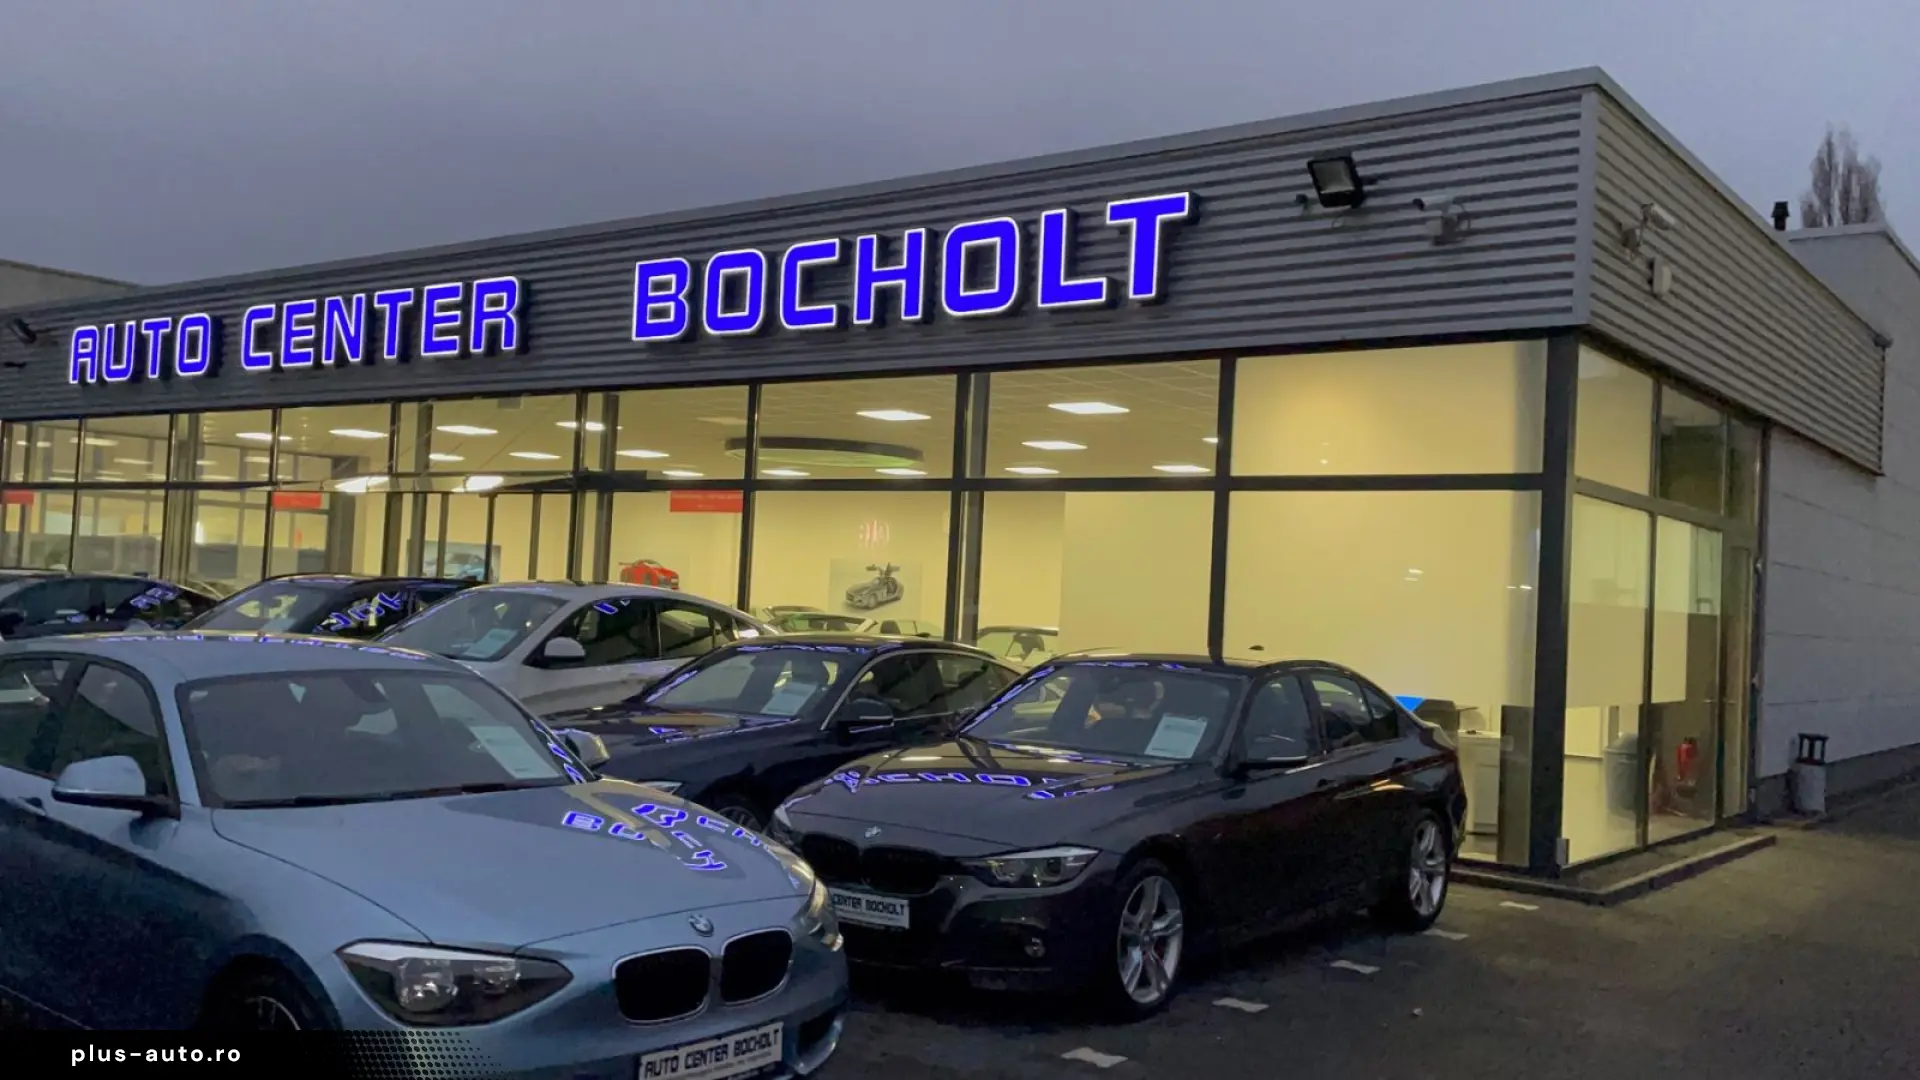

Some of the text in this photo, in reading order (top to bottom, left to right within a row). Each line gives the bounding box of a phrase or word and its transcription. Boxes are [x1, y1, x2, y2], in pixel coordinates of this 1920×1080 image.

[69, 192, 1190, 385] AUTO CENTER BOCHOLT
[865, 899, 905, 916] BOCHOLT
[644, 1055, 679, 1079] AUTO
[684, 1043, 729, 1070] CENTER
[733, 1028, 780, 1057] BOCHOLT
